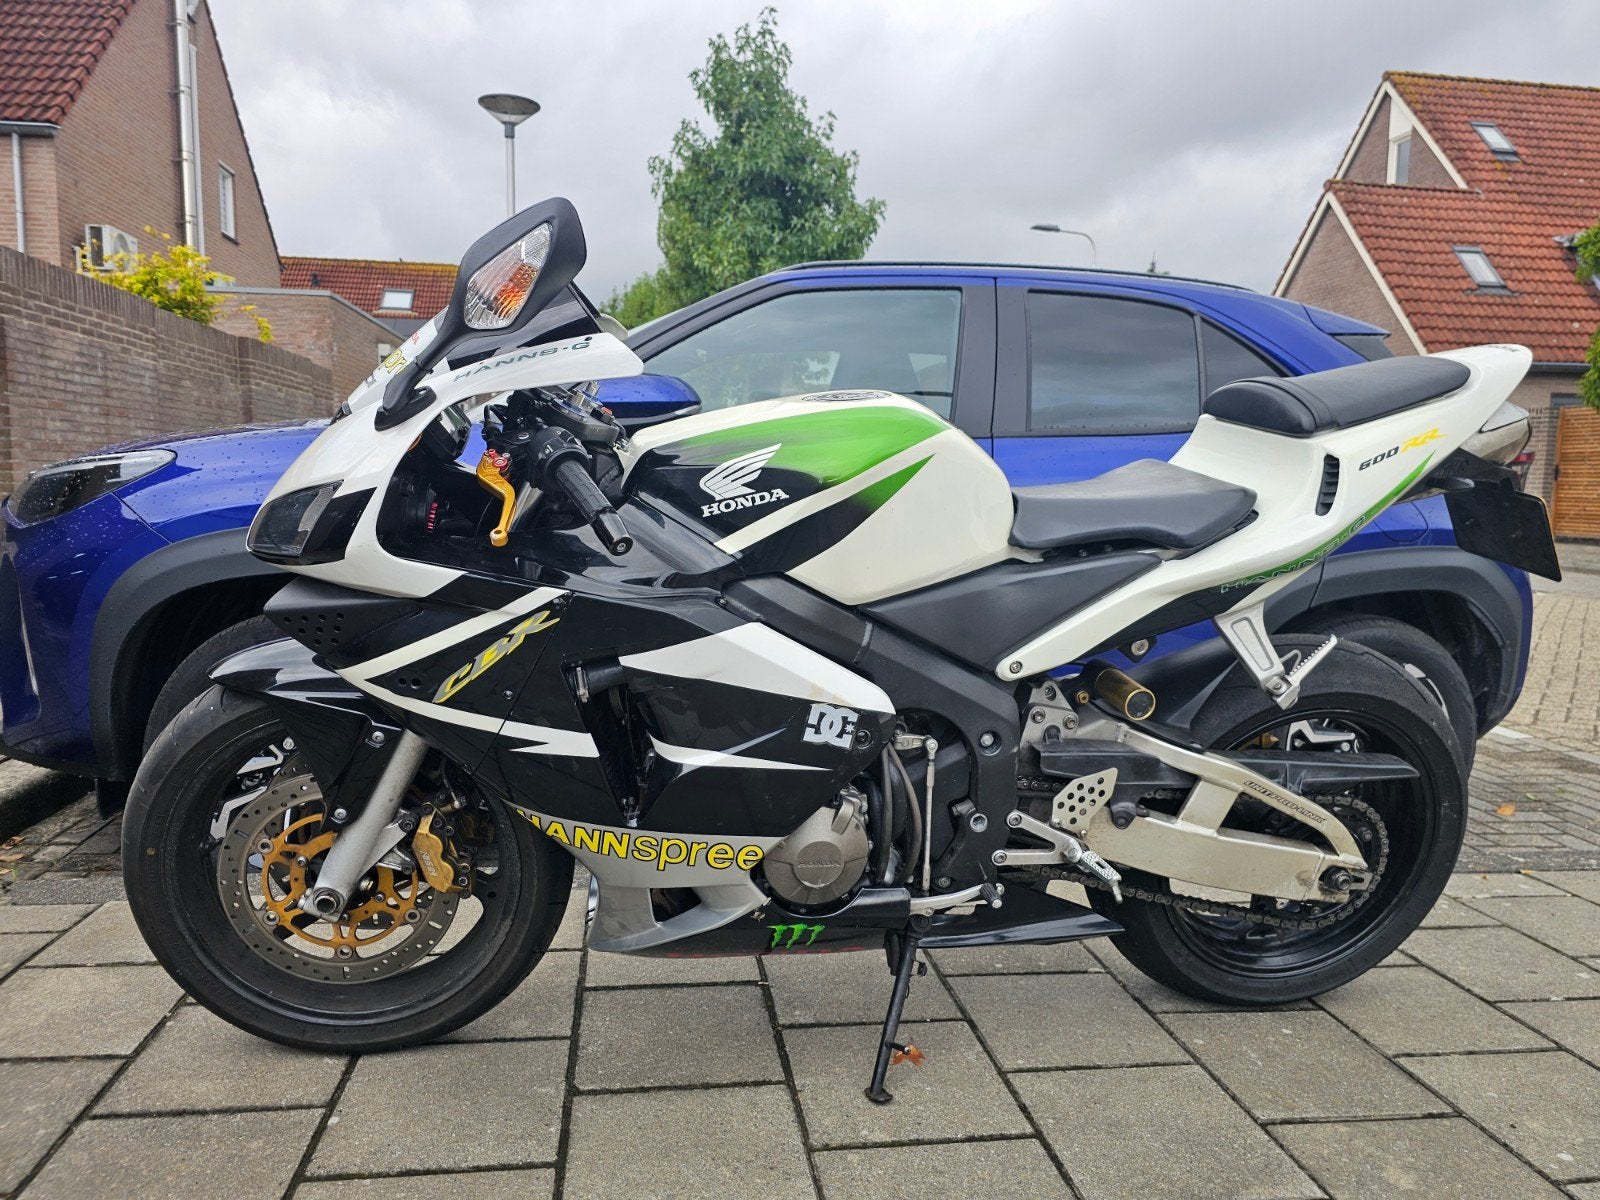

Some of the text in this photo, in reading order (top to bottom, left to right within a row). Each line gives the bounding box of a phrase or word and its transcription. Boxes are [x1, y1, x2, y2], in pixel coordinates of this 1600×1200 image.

[701, 488, 790, 518] HONDA
[432, 610, 561, 704] CBR
[802, 703, 860, 749] DC
[797, 859, 841, 868] HONDA
